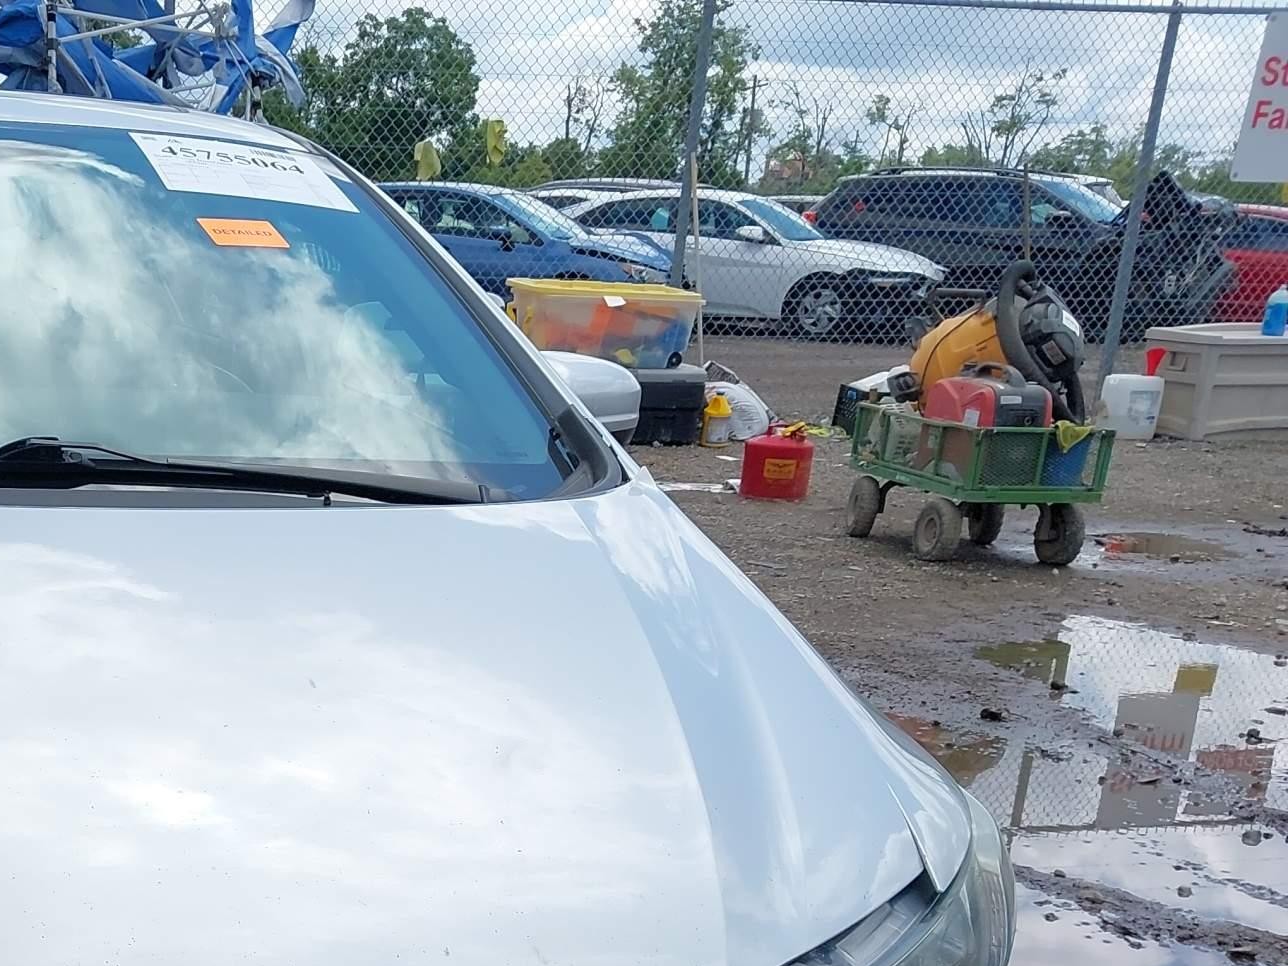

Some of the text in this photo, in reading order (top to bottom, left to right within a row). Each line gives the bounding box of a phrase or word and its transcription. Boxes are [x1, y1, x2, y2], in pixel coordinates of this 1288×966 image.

[1252, 101, 1288, 129] Fa
[161, 145, 305, 175] 45755064
[212, 228, 273, 237] DETAILED
